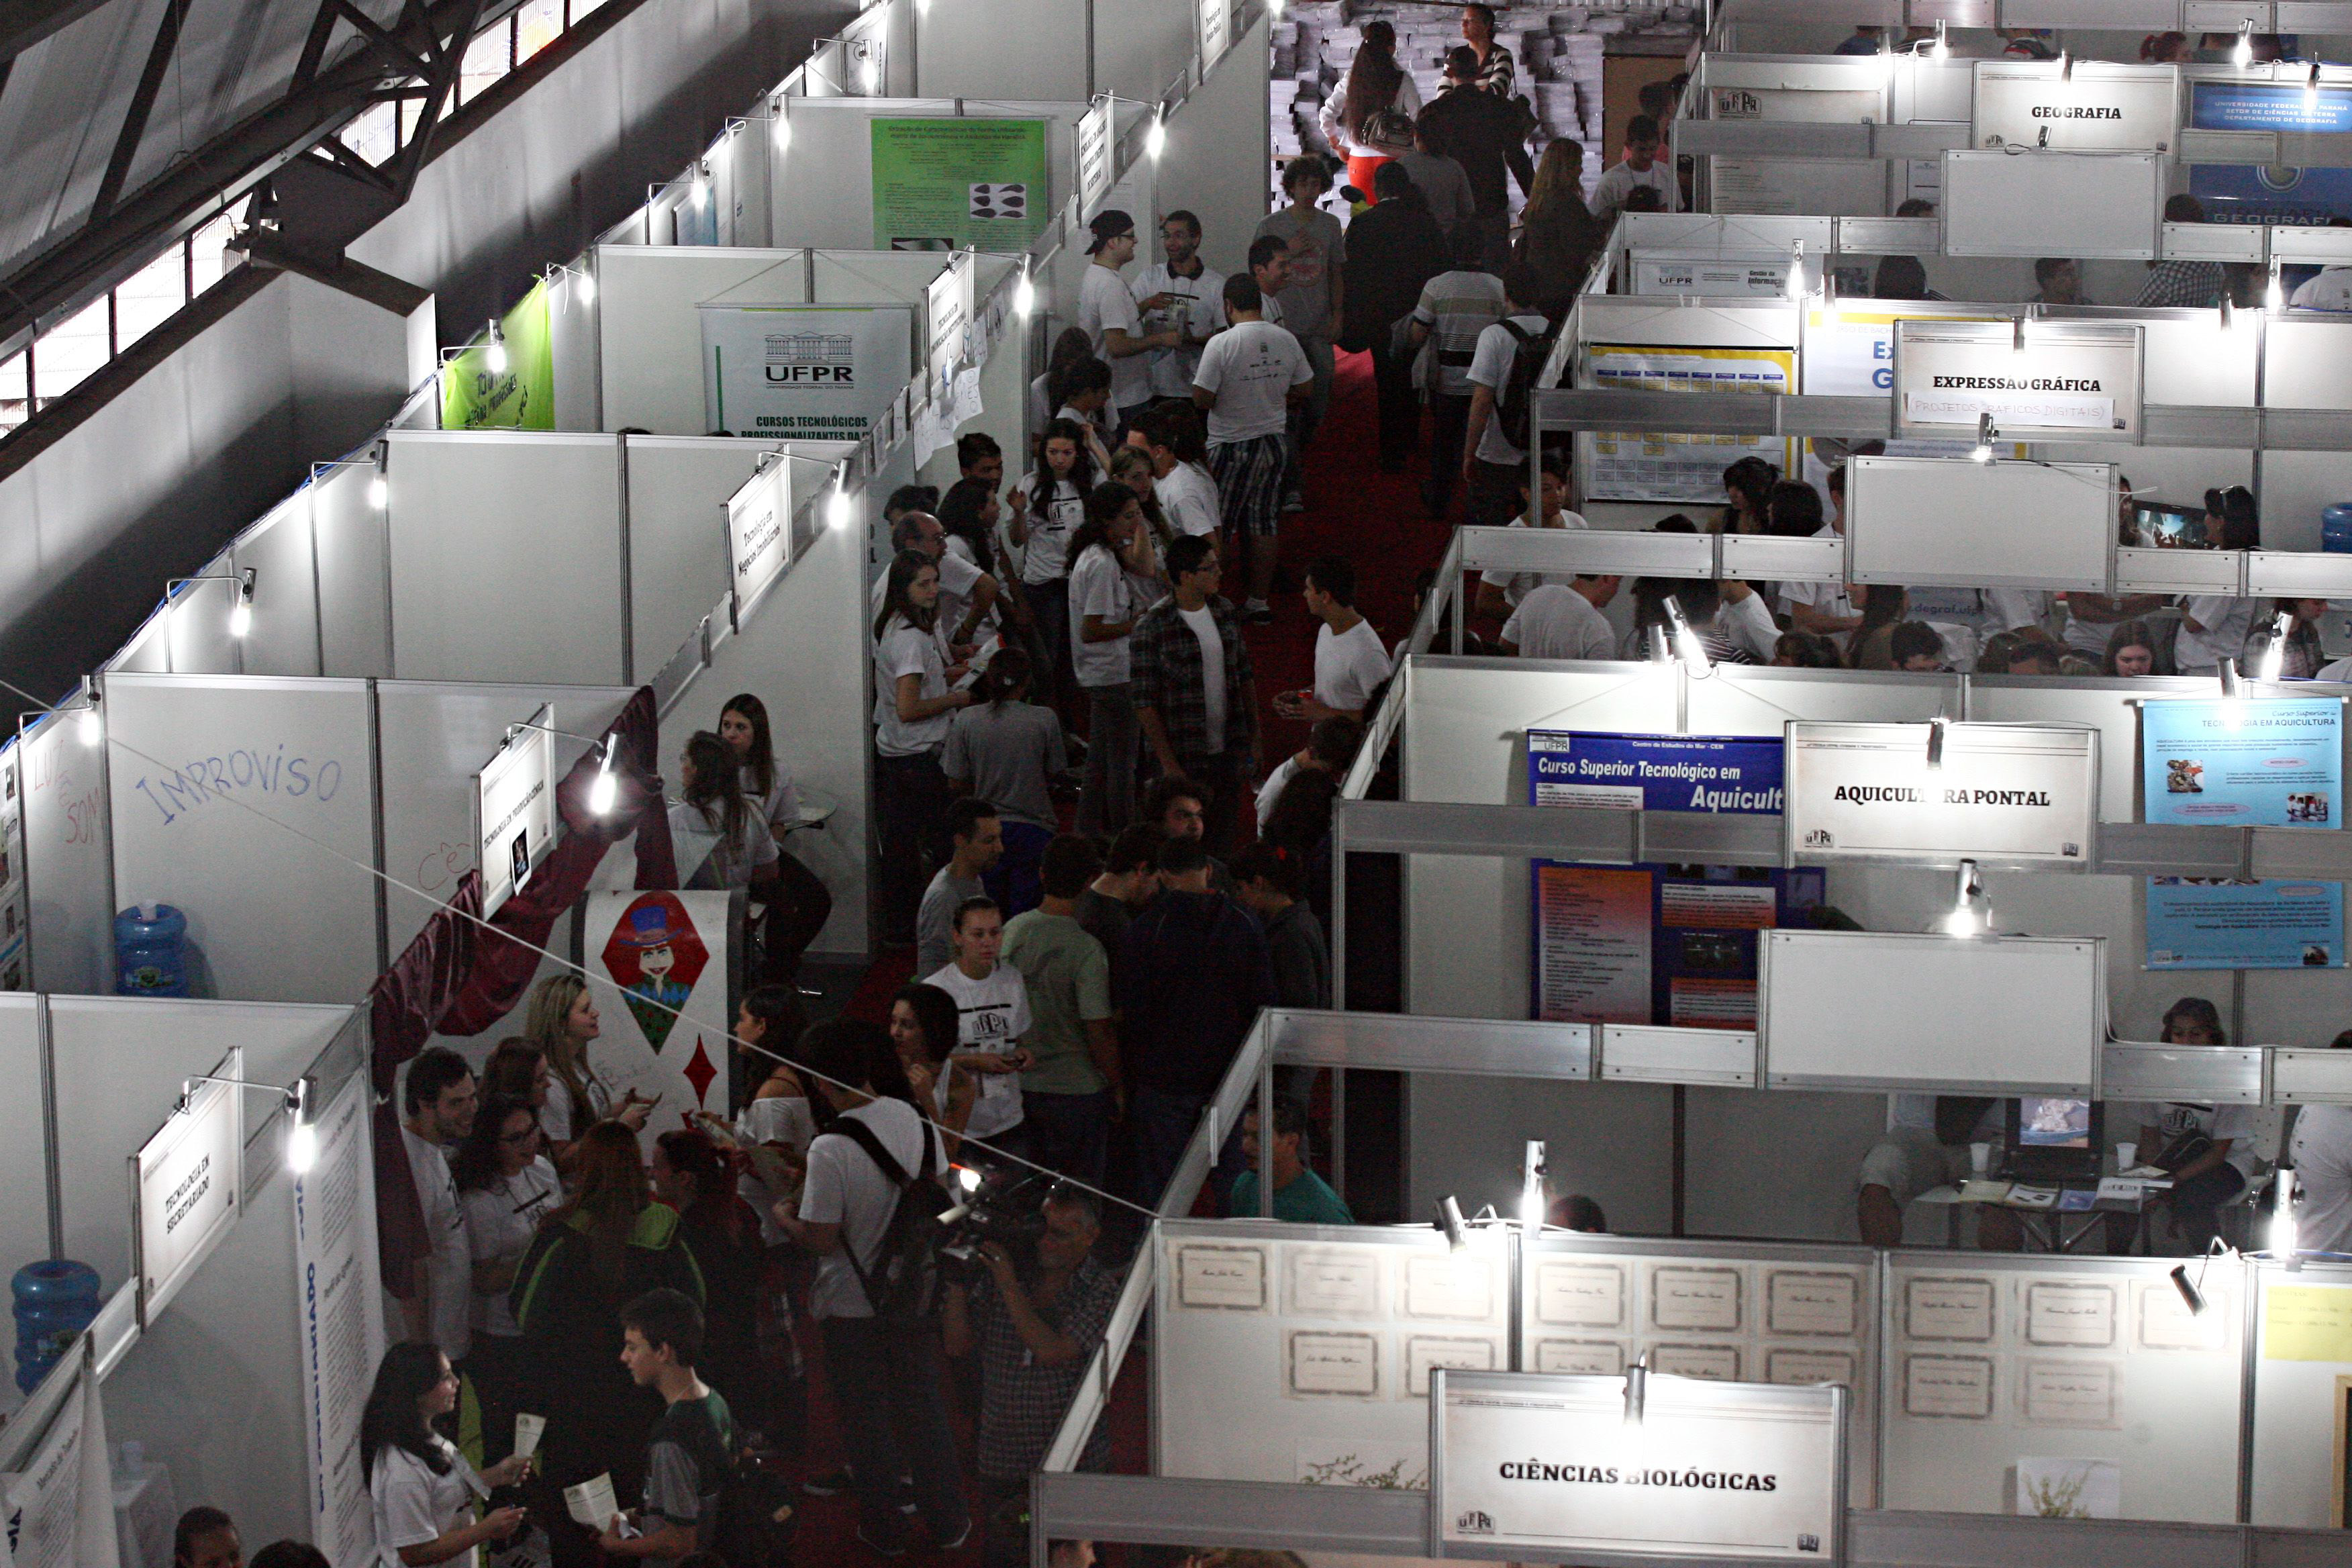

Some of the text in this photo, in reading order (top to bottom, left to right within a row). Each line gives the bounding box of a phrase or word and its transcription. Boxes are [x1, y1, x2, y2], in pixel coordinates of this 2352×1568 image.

[2032, 107, 2121, 119] GEOGRAFIA
[2214, 213, 2331, 226] GEOGRAFI
[766, 366, 853, 381] UFPR
[1933, 374, 2102, 392] EXPRESSÃO GRÁFICA
[756, 415, 868, 428] CURSOS TECNOLÓGICOS
[741, 431, 844, 440] PROFISSIONALIZANTES
[744, 508, 772, 548] Tecnologia em
[738, 547, 756, 579] Negócios
[2260, 719, 2273, 727] EM
[1545, 741, 1568, 750] UFPR
[1538, 757, 1741, 782] Curso Superior Tecnológico em
[1834, 785, 2050, 806] AQUICULTRA PONTAL
[485, 820, 506, 850] TECNOLOGIA
[165, 1151, 209, 1214] TECNOLOGIA EM
[167, 1175, 209, 1233] SECRETARIADO
[1500, 1457, 1618, 1484] CIÊNCIAS
